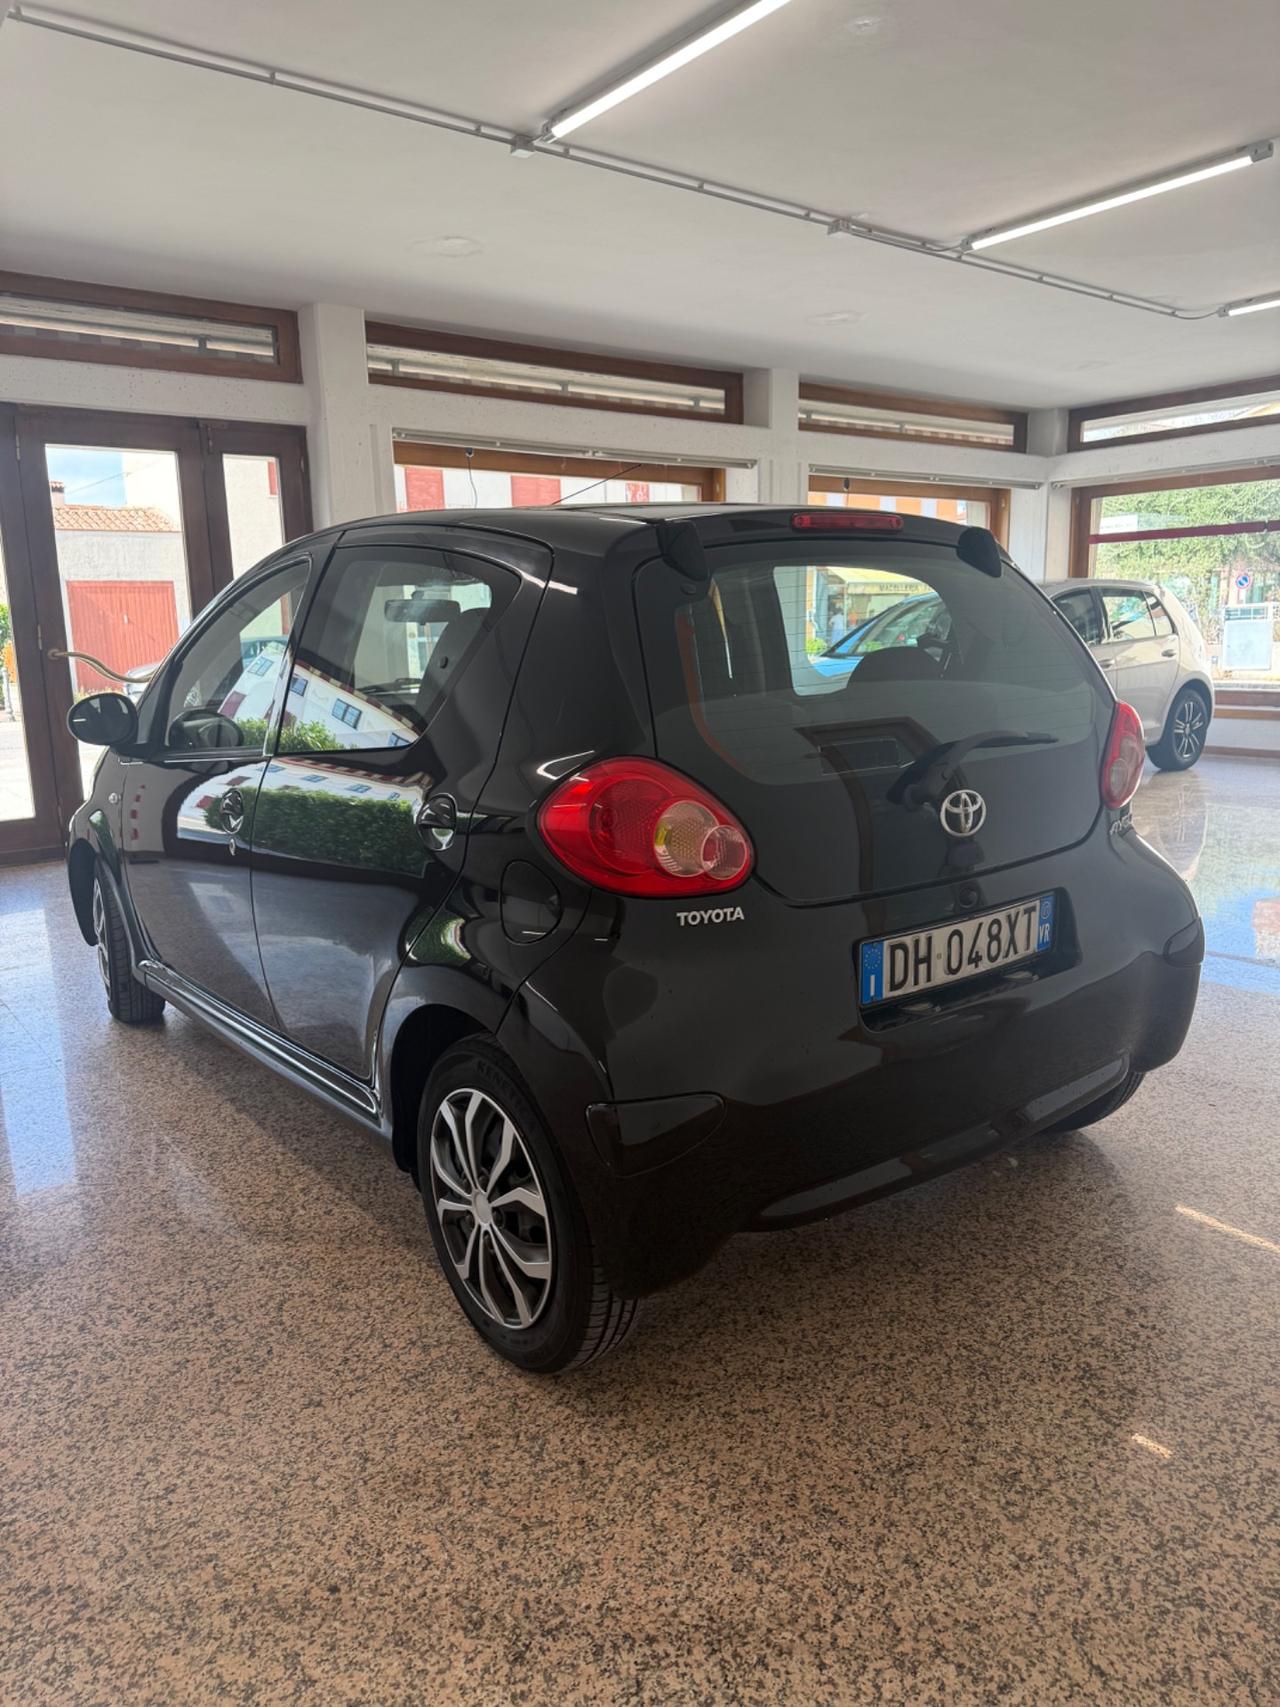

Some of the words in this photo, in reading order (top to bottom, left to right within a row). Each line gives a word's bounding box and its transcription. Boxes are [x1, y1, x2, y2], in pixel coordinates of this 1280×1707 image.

[676, 906, 745, 926] TOYOTA
[1039, 922, 1051, 944] VR
[889, 935, 932, 992] DH
[946, 906, 1037, 975] 048XT
